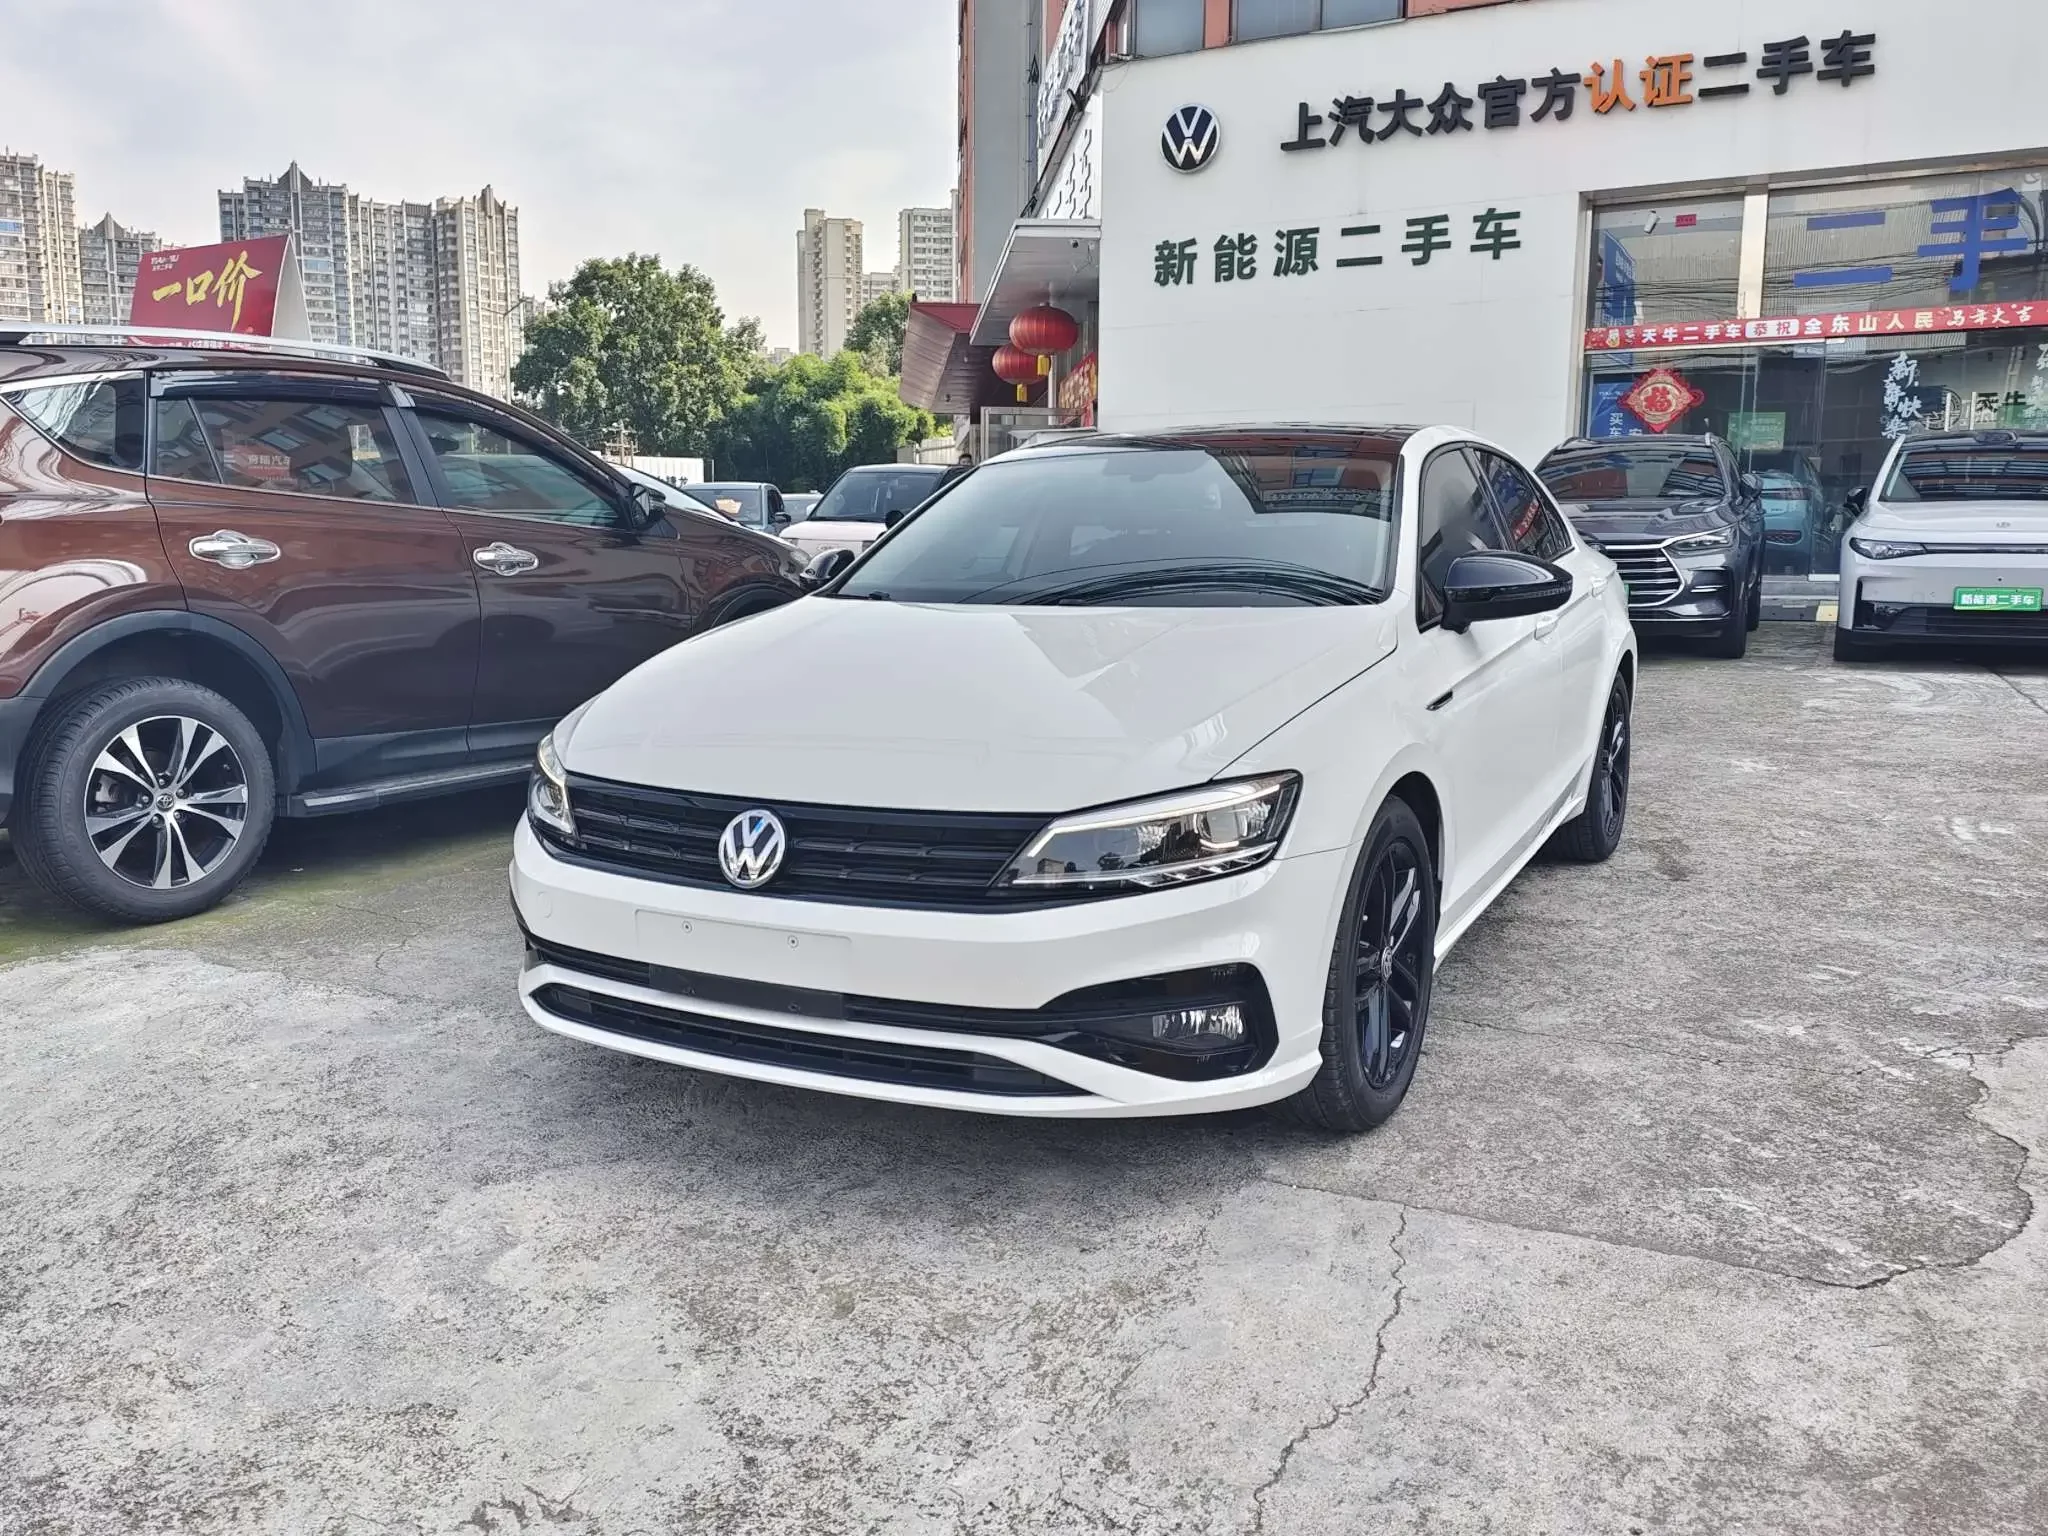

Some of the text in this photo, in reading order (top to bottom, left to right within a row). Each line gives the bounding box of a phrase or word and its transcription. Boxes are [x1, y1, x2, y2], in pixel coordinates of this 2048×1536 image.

[1280, 30, 1877, 151] 上汽大众官方认证二手车
[1153, 208, 1523, 287] 新能源二手车
[152, 250, 263, 331] 一口价
[1960, 593, 2035, 605] 新能源二手车
